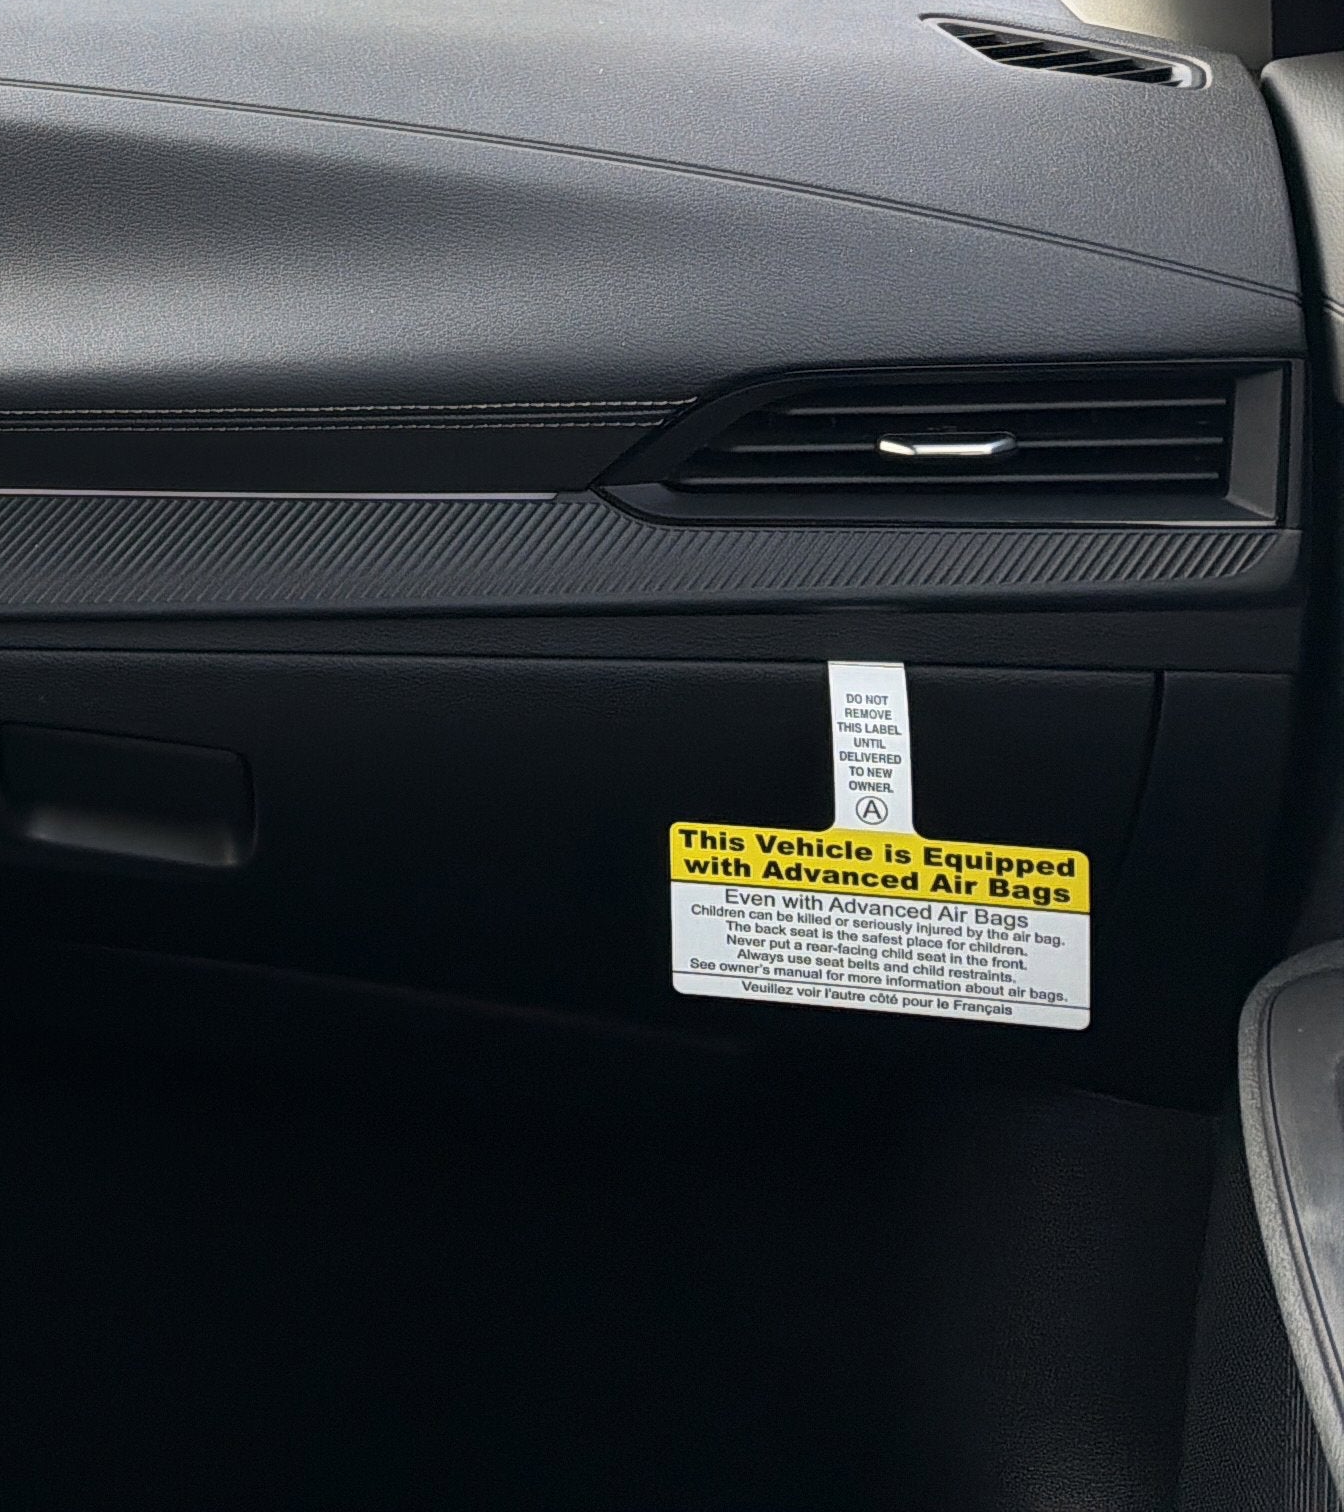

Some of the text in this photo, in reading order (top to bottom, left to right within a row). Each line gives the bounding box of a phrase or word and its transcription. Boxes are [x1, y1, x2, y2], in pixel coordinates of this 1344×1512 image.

[845, 708, 892, 720] REMOVE
[846, 694, 888, 705] DO NOT
[837, 722, 902, 735] THIS LABEL
[854, 737, 886, 749] UNTIL
[839, 751, 902, 764] DELIVERED
[849, 766, 893, 778] TO NEW
[849, 781, 894, 793] OWNER.
[678, 829, 1075, 878] This Vehicle is Equipped
[684, 858, 1071, 906] with Advanced Air Bags
[691, 904, 1065, 948] Children can be killed or seriously injured by the air bag.
[725, 888, 1029, 931] Even with Advanced Air Bags
[726, 921, 1027, 956] The back seat is the safest place for children.
[727, 935, 1027, 970] Never put a rear-facing child seat in the front.
[690, 959, 1068, 1003] See owner's manual for more information about air bags.
[737, 949, 1016, 983] Always use seat belts and child restraints.
[742, 981, 1013, 1016] Veuillez voir l'autre côté pour le Français
